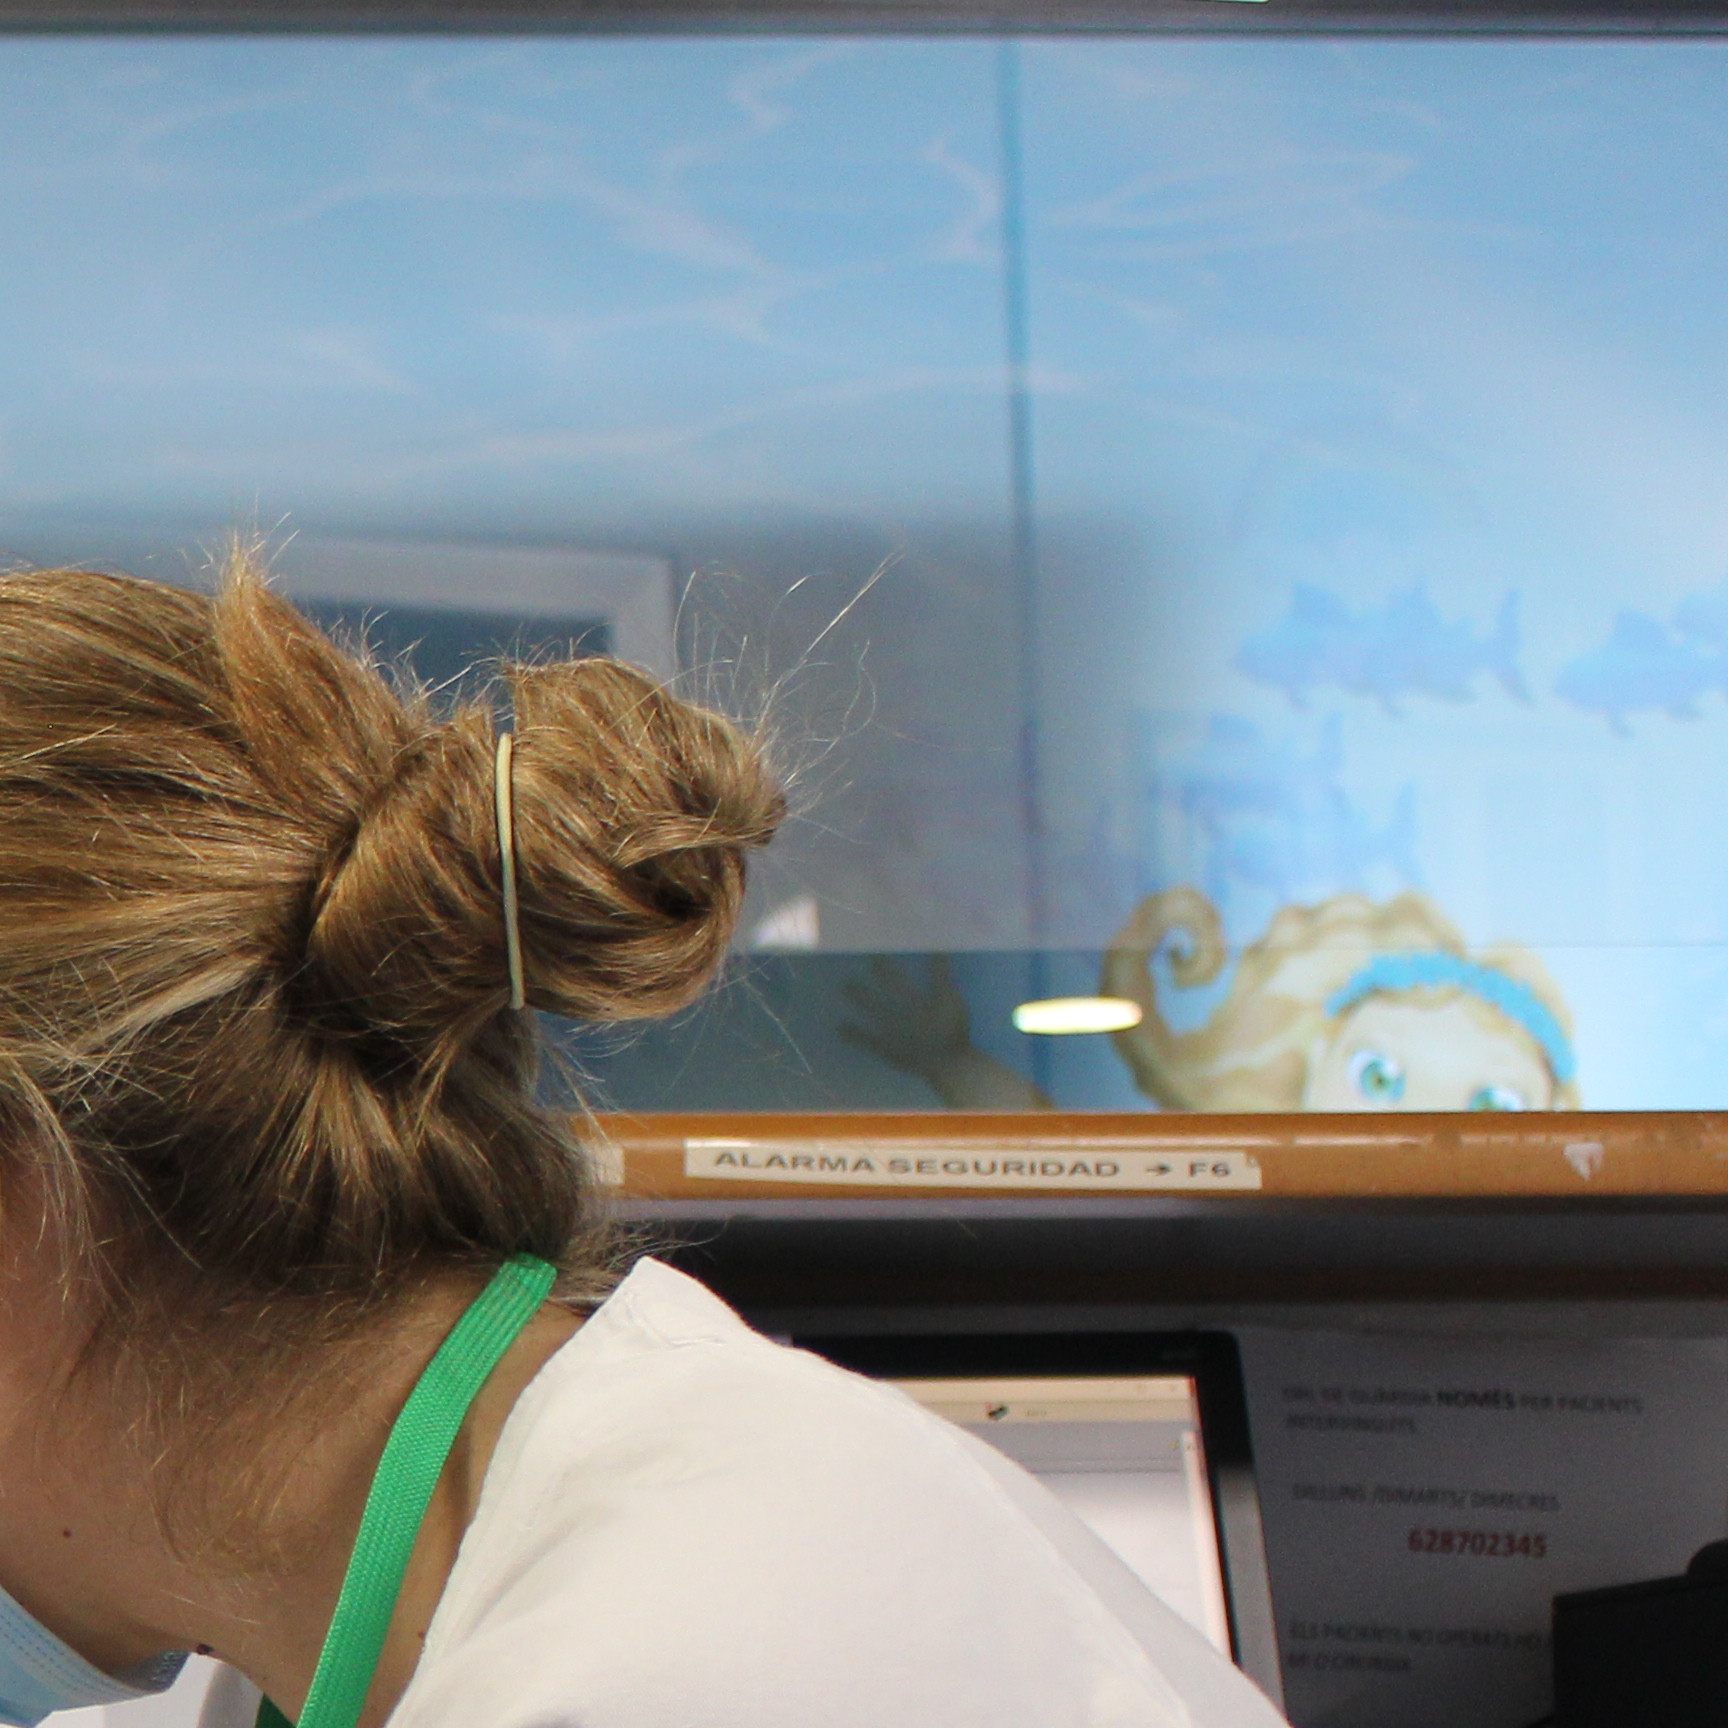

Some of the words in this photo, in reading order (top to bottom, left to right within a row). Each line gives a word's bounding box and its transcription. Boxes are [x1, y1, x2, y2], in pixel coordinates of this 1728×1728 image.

[712, 1152, 877, 1177] ALARMA
[886, 1159, 1121, 1177] SEGURIDAD
[1187, 1161, 1232, 1178] F6
[1408, 1527, 1547, 1558] 628702345
